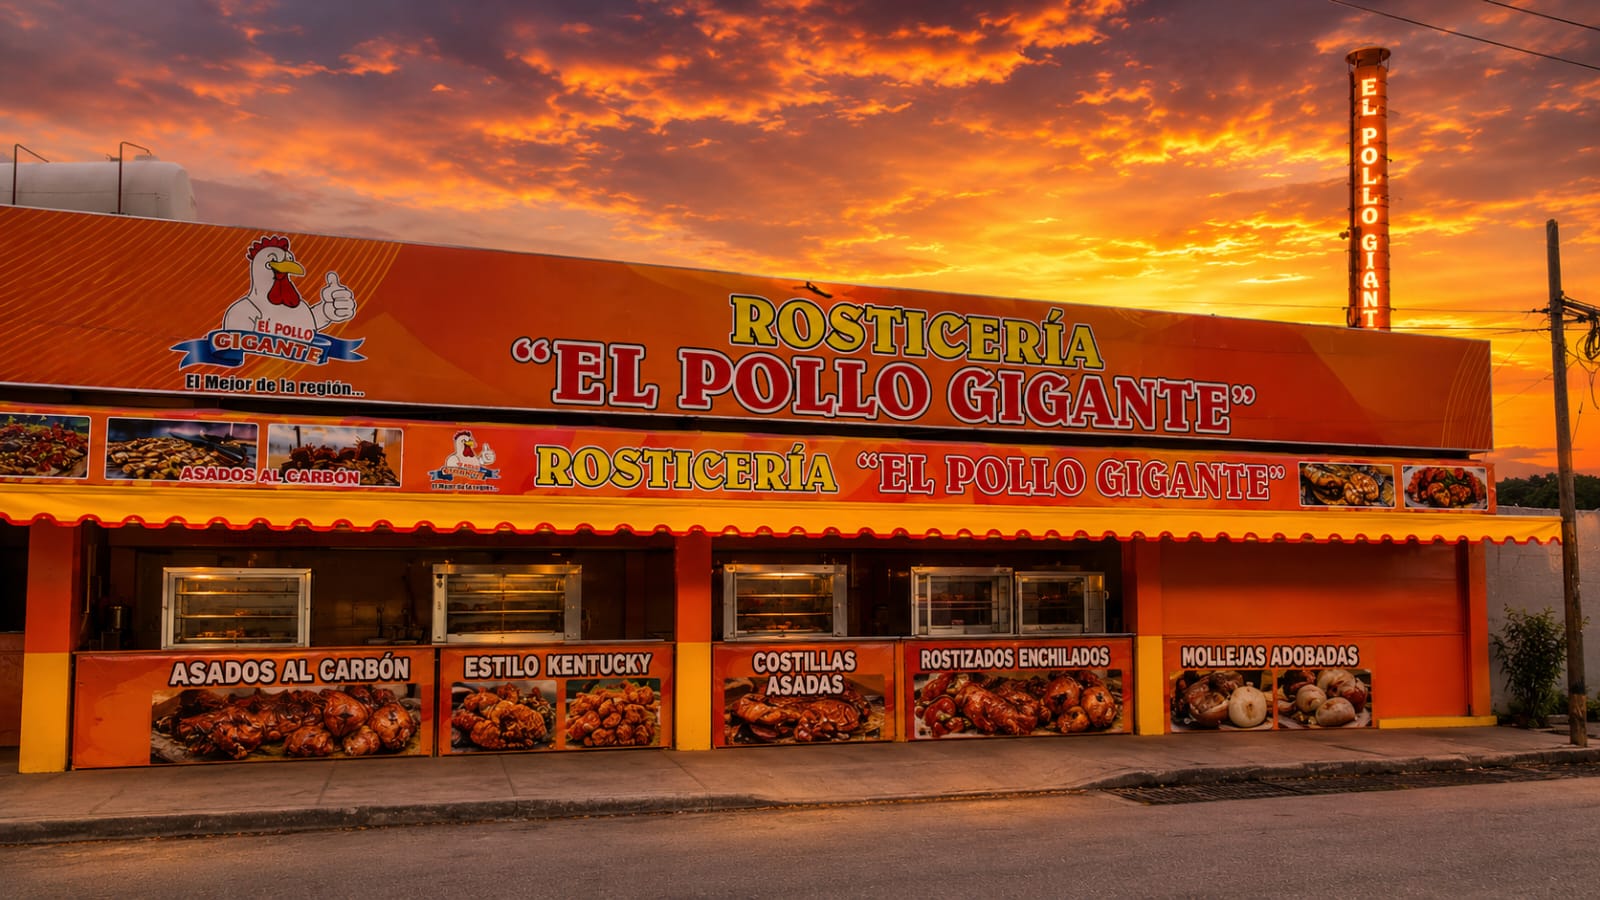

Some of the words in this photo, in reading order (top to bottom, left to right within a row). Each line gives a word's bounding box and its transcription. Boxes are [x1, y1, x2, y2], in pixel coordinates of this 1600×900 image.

[1361, 77, 1378, 116] EL
[1361, 127, 1378, 225] POLLO
[258, 321, 270, 332] EL
[274, 323, 313, 341] POLLO
[730, 294, 1104, 370] ROSTICERÍA
[213, 333, 323, 363] GIGANTE
[186, 374, 200, 389] El
[205, 375, 252, 391] Mejor
[256, 378, 276, 393] de
[280, 379, 296, 394] la
[300, 381, 364, 396] región...
[511, 337, 658, 409] “EL
[678, 348, 931, 419] POLLO
[947, 366, 1255, 435] GIGANTE”
[179, 467, 256, 482] ASADOS
[259, 469, 283, 482] AL
[286, 468, 361, 486] CARBÓN
[534, 443, 839, 493] ROSTICERÍA
[857, 453, 934, 495] “EL
[945, 455, 1086, 497] POLLO
[1095, 460, 1285, 500] GIGANTE”
[169, 660, 276, 687] ASADOS
[281, 659, 313, 683] AL
[319, 652, 410, 682] CARBÓN
[464, 655, 540, 679] ESTILO
[546, 653, 653, 677] KENTUCKY
[752, 650, 857, 674] COSTILLAS
[920, 648, 1015, 670] ROSTIZADOS
[1018, 646, 1111, 668] ENCHILADOS
[1181, 646, 1267, 668] MOLLEJAS
[1270, 646, 1360, 668] ADOBADAS
[765, 674, 845, 697] ASADAS
